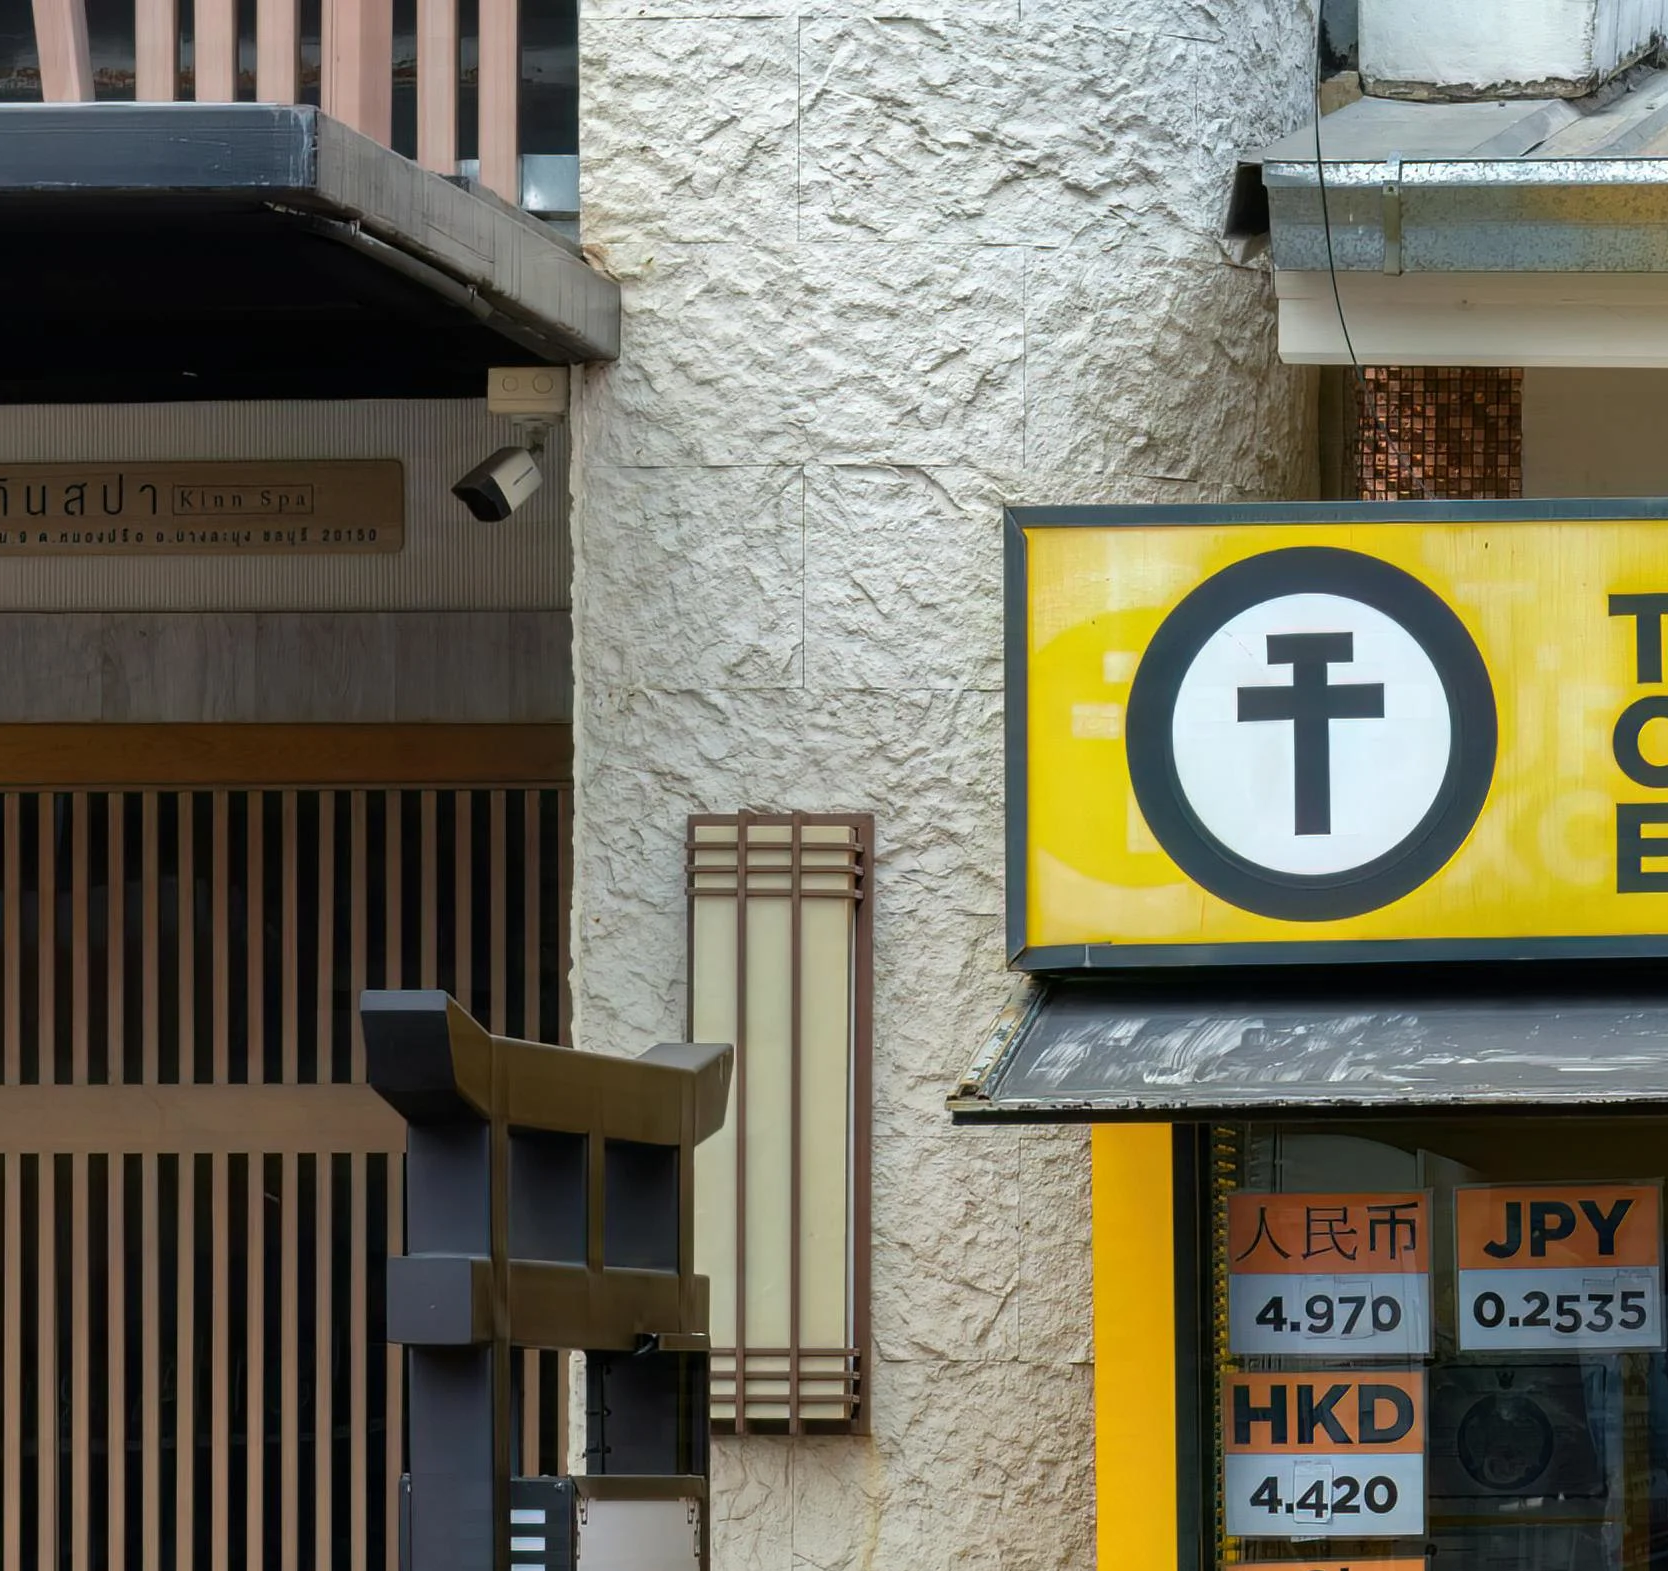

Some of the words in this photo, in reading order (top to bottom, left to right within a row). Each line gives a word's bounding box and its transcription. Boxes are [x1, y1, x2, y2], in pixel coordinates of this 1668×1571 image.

[260, 489, 306, 513] Spa
[321, 529, 377, 542] 20150
[1234, 1200, 1419, 1262] 人民币
[1482, 1199, 1635, 1259] JPY
[1254, 1294, 1402, 1335] 4.970
[1473, 1290, 1647, 1333] 0.2535
[1233, 1383, 1415, 1445] HKD
[1249, 1475, 1399, 1519] 4.420
